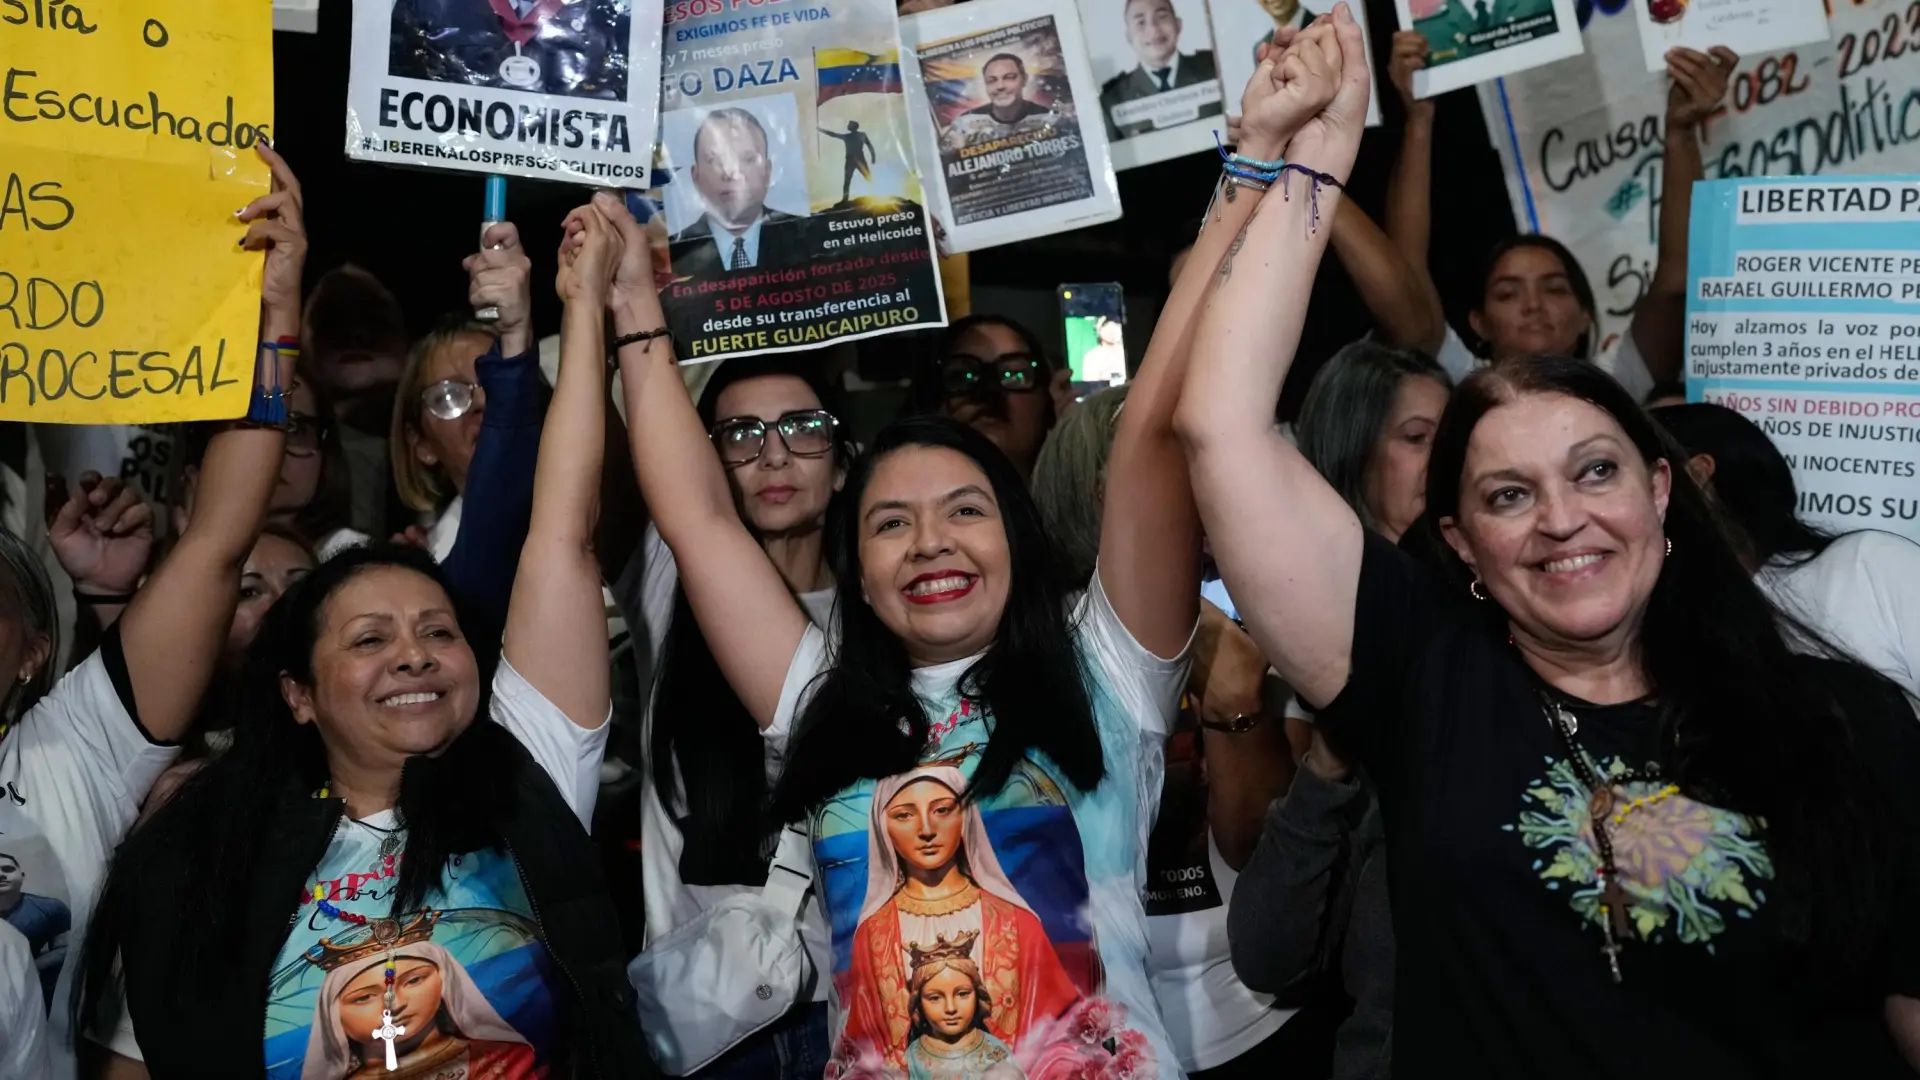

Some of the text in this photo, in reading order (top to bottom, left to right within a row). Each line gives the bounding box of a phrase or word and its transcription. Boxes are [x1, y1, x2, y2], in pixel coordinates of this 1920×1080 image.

[676, 7, 831, 42] EXIGIMOS FE DE VIDA
[667, 38, 784, 68] y 7 meses preso
[713, 57, 800, 93] DAZA
[4, 67, 270, 149] Escuchados
[379, 88, 631, 153] ECONOMISTA
[948, 147, 1023, 177] ALEJANDRO
[1027, 135, 1080, 159] TORRES
[1541, 114, 1666, 191] Causa
[1741, 187, 1892, 214] LIBERTAD
[828, 208, 916, 233] Estuvo preso
[822, 224, 923, 250] en el Helicoide
[672, 246, 930, 300] En desaparición forzada desde
[1736, 257, 1801, 272] ROGER
[1808, 256, 1894, 273] VICENTE
[715, 272, 897, 313] 5 DE AGOSTO DE 2025
[1701, 281, 1765, 298] RAFAEL
[1771, 281, 1892, 299] GUILLERMO
[703, 287, 911, 333] desde su transferencia al
[691, 306, 919, 357] FUERTE GUAICAIPURO
[1690, 319, 1718, 338] Hoy
[1735, 318, 1808, 335] alzamos
[1818, 319, 1835, 335] la
[1846, 323, 1879, 336] voz
[1690, 340, 1758, 360] cumplen
[1762, 342, 1773, 357] 3
[1777, 341, 1822, 359] años
[1827, 346, 1850, 360] en
[1855, 344, 1873, 360] el
[1693, 359, 1919, 380] injustamente privados de
[1767, 398, 1798, 414] SIN
[1803, 400, 1879, 418] DEBIDO
[1883, 401, 1920, 418] PRO
[1808, 421, 1832, 438] DE
[1804, 455, 1915, 477] INOCENTES
[1800, 490, 1918, 520] IMOS SU
[1160, 865, 1205, 883] TODOS
